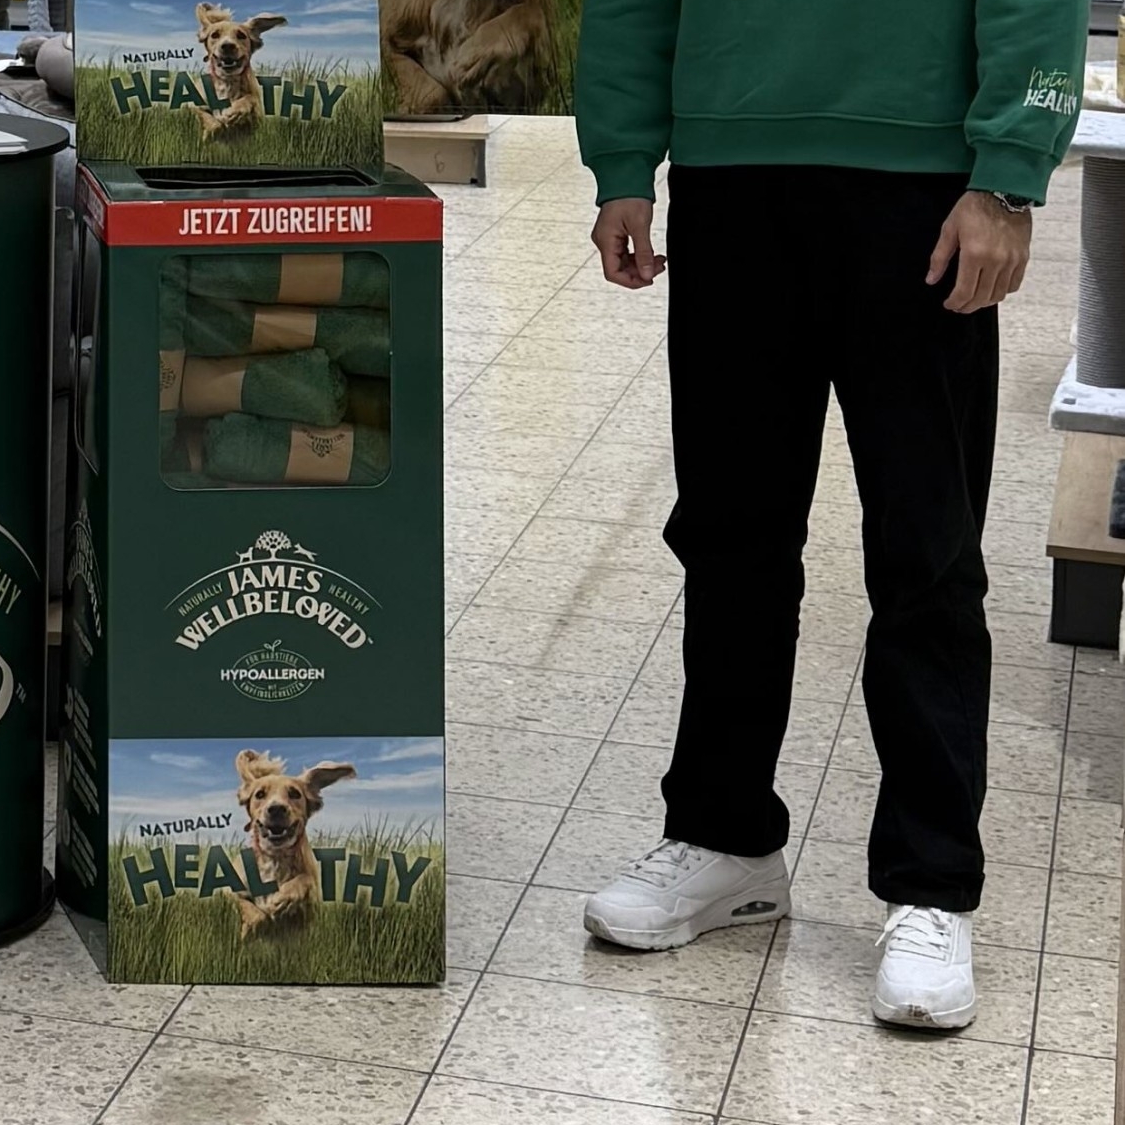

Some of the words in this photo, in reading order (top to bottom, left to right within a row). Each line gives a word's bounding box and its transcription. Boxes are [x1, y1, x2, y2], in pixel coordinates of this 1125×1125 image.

[123, 48, 195, 64] NATURALLY
[178, 208, 241, 235] JETZT
[247, 206, 372, 234] ZUGREIFEN!
[227, 565, 323, 596] JAMES
[177, 581, 223, 617] NATURALLY
[328, 583, 370, 616] HEALTHY
[220, 668, 325, 681] HYPOALLERGEN
[139, 813, 233, 838] NATURALLY
